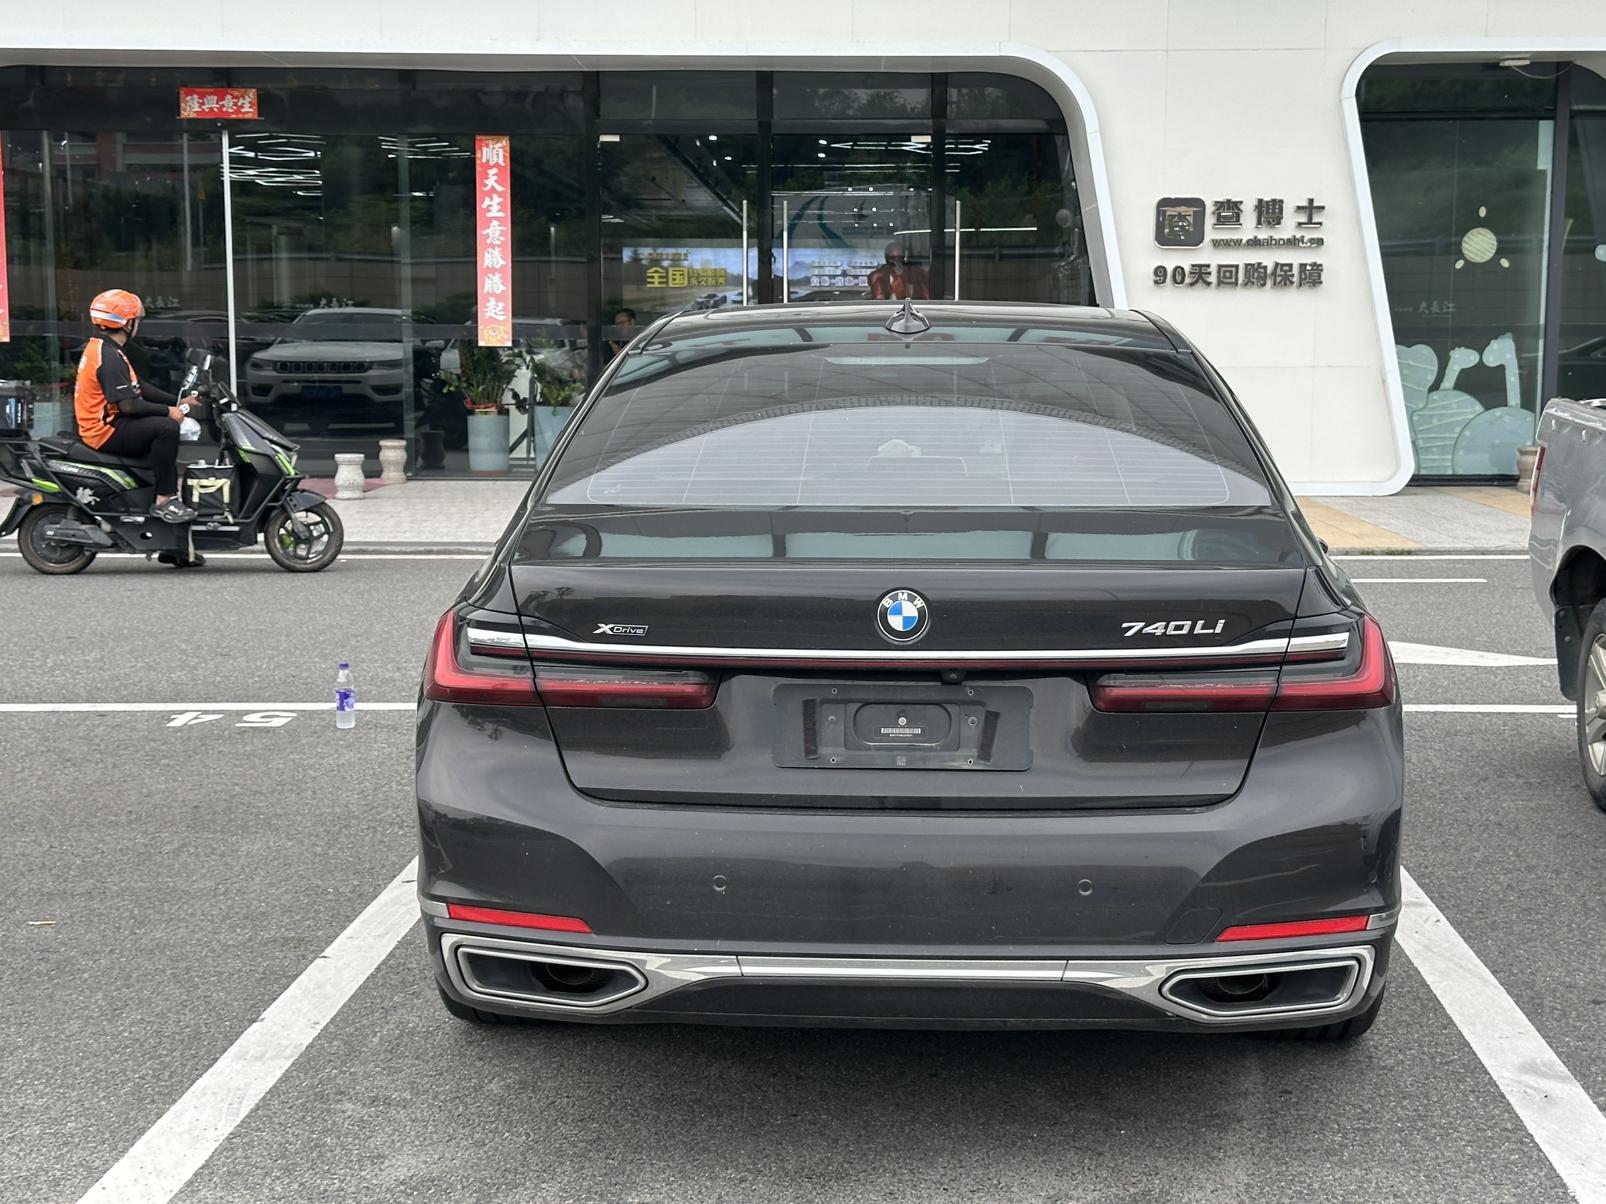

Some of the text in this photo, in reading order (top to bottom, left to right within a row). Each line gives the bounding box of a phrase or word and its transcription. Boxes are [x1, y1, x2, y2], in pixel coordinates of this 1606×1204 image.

[1211, 197, 1326, 229] 查博士
[646, 266, 688, 288] 全国
[1153, 261, 1324, 288] 90天回购保障
[882, 592, 925, 608] BMW
[1121, 619, 1226, 636] 740Li
